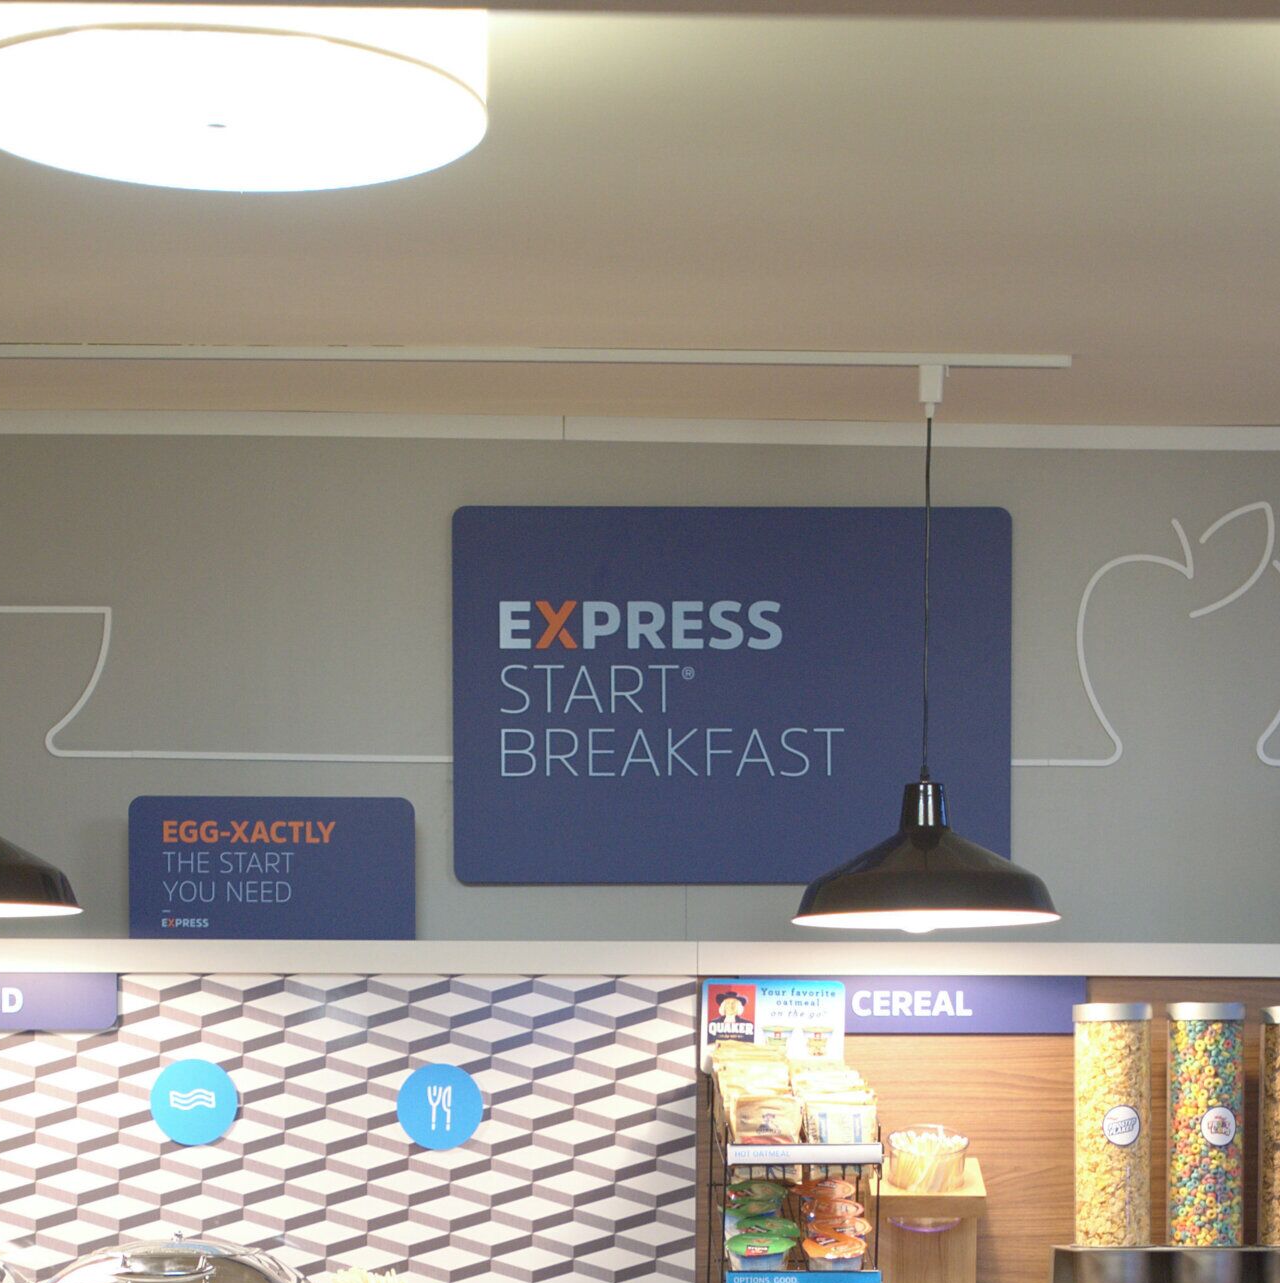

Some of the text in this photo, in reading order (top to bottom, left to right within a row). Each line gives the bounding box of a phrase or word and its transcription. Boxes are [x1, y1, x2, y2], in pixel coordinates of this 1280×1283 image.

[499, 600, 784, 650] EXPRESS
[500, 727, 845, 777] BREAKFAST
[162, 820, 336, 844] EGG-XACTLY
[163, 851, 295, 874] THE START
[162, 881, 292, 903] YOU NEED
[161, 918, 209, 928] EXPRESS
[761, 987, 836, 997] Your favorite
[851, 990, 973, 1017] CEREAL
[708, 1022, 755, 1036] QUAKER
